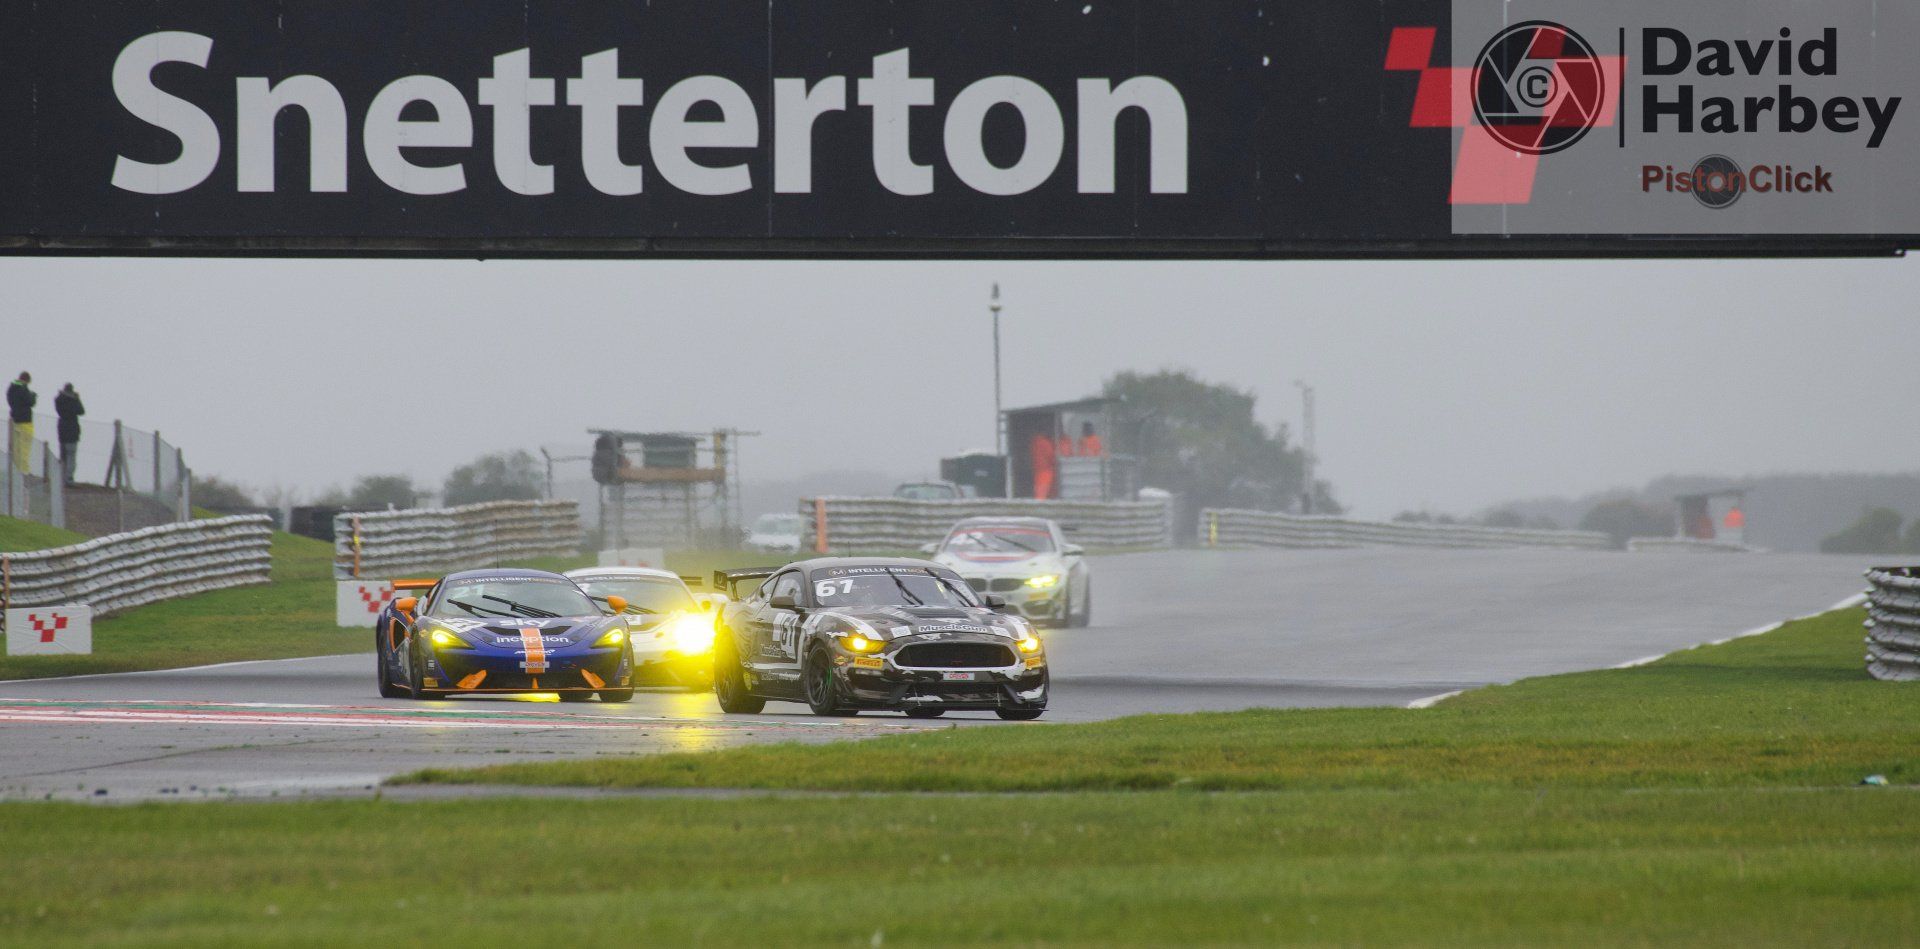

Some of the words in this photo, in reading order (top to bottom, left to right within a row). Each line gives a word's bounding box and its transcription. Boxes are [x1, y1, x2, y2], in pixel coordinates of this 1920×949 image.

[112, 32, 1188, 196] Snetterton
[453, 584, 484, 599] 21
[816, 579, 854, 598] 61
[499, 618, 551, 629] sky
[919, 624, 987, 633] MuscleGun
[496, 635, 570, 644] inception
